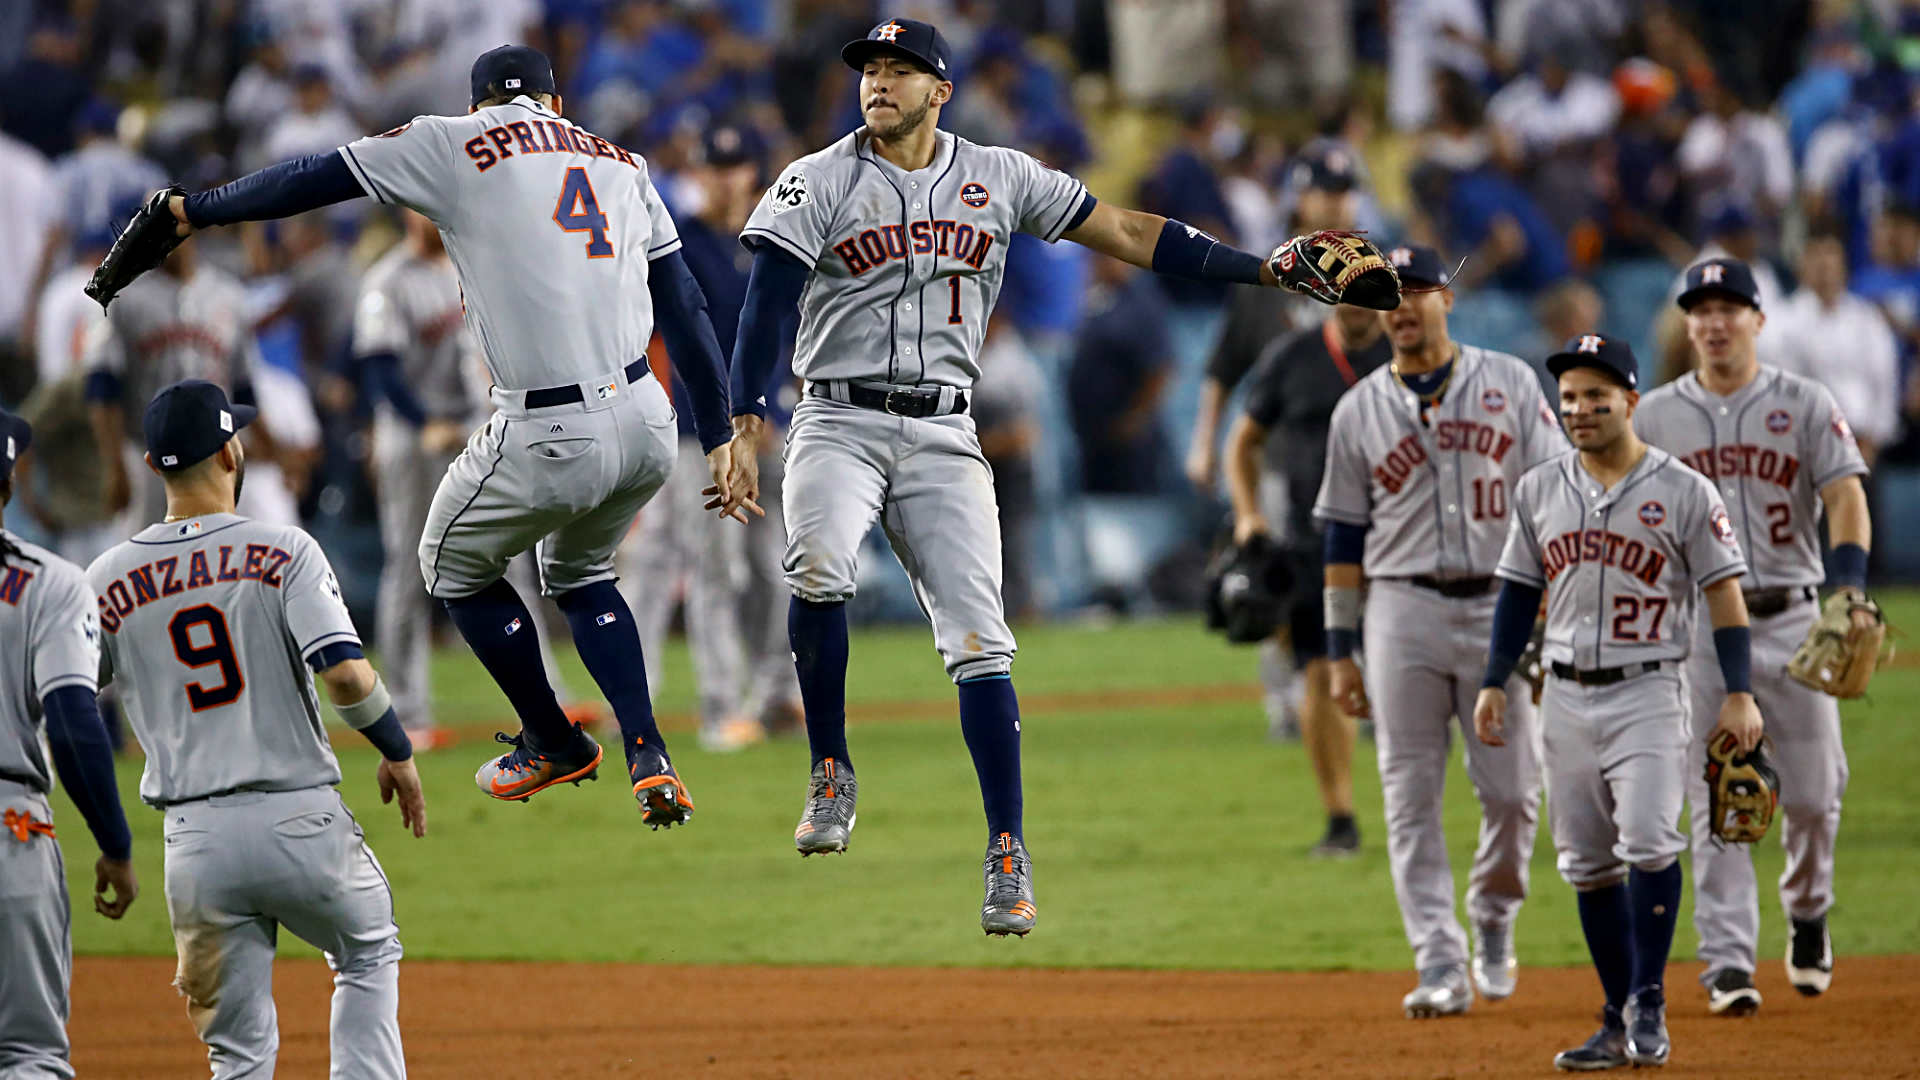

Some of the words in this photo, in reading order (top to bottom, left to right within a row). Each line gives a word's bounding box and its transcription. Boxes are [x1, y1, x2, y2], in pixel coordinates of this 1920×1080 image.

[465, 120, 640, 172] SPRINGER
[552, 166, 615, 259] 4
[776, 184, 806, 206] WS
[832, 220, 995, 277] HOUSTON
[948, 274, 963, 325] 1
[1472, 477, 1506, 521] 10
[1766, 502, 1795, 547] 2
[97, 543, 292, 634] GONZALEZ
[1611, 595, 1669, 641] 27
[168, 602, 245, 713] 9
